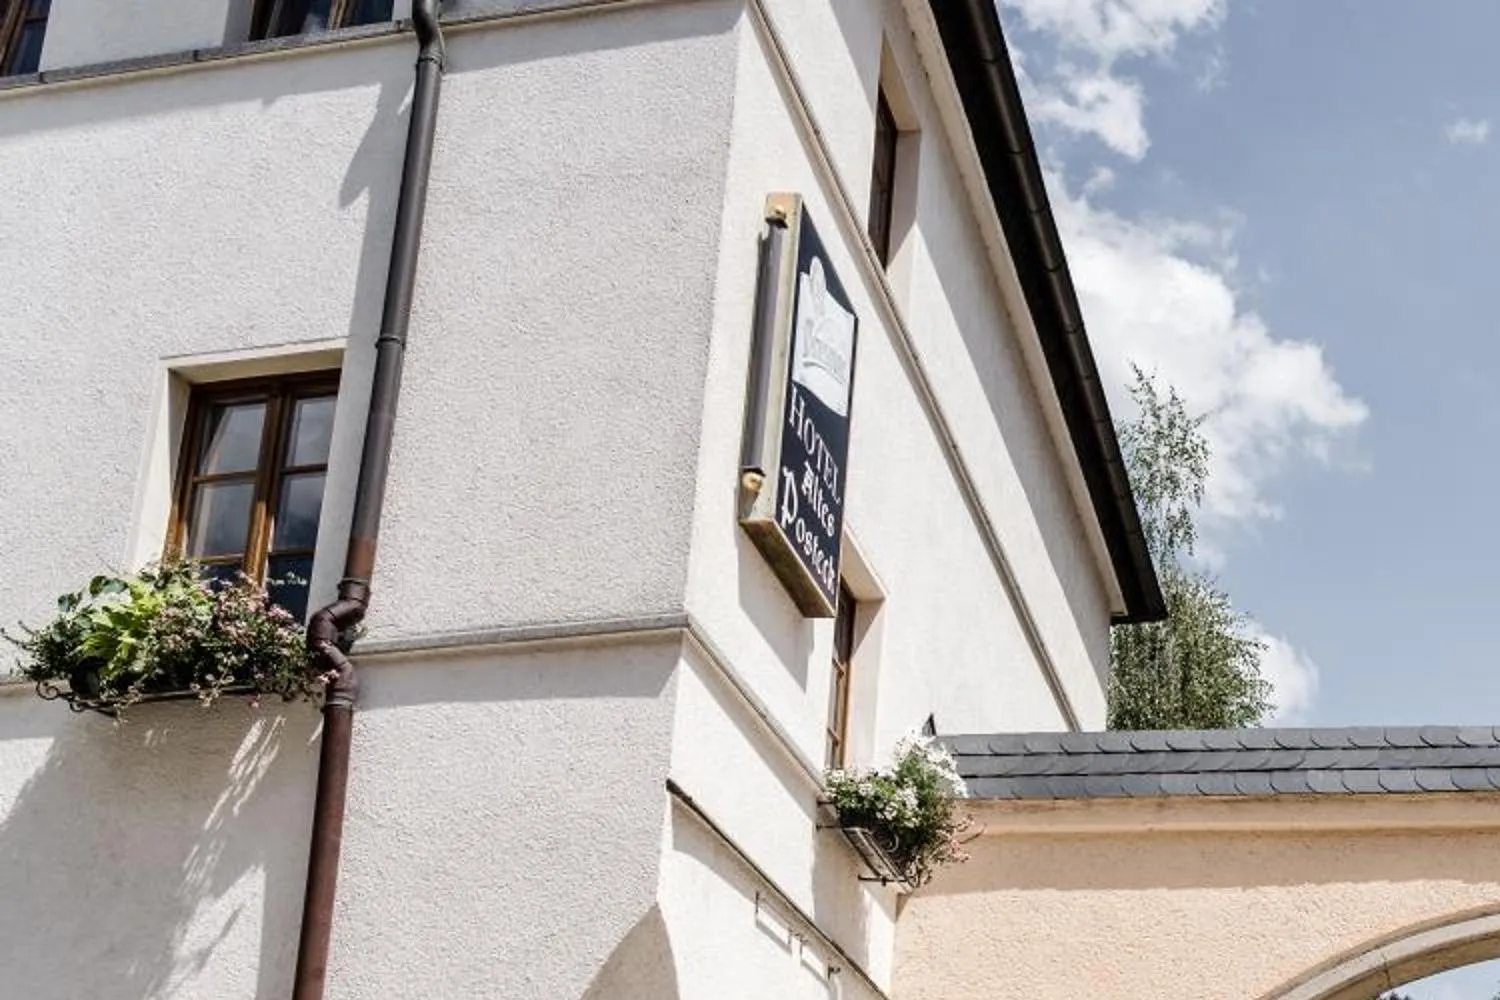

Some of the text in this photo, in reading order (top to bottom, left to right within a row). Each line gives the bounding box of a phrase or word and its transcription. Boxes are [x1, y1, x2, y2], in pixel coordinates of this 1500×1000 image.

[788, 384, 841, 505] HOTEL
[800, 461, 835, 538] Altes
[780, 466, 835, 595] Posteck
